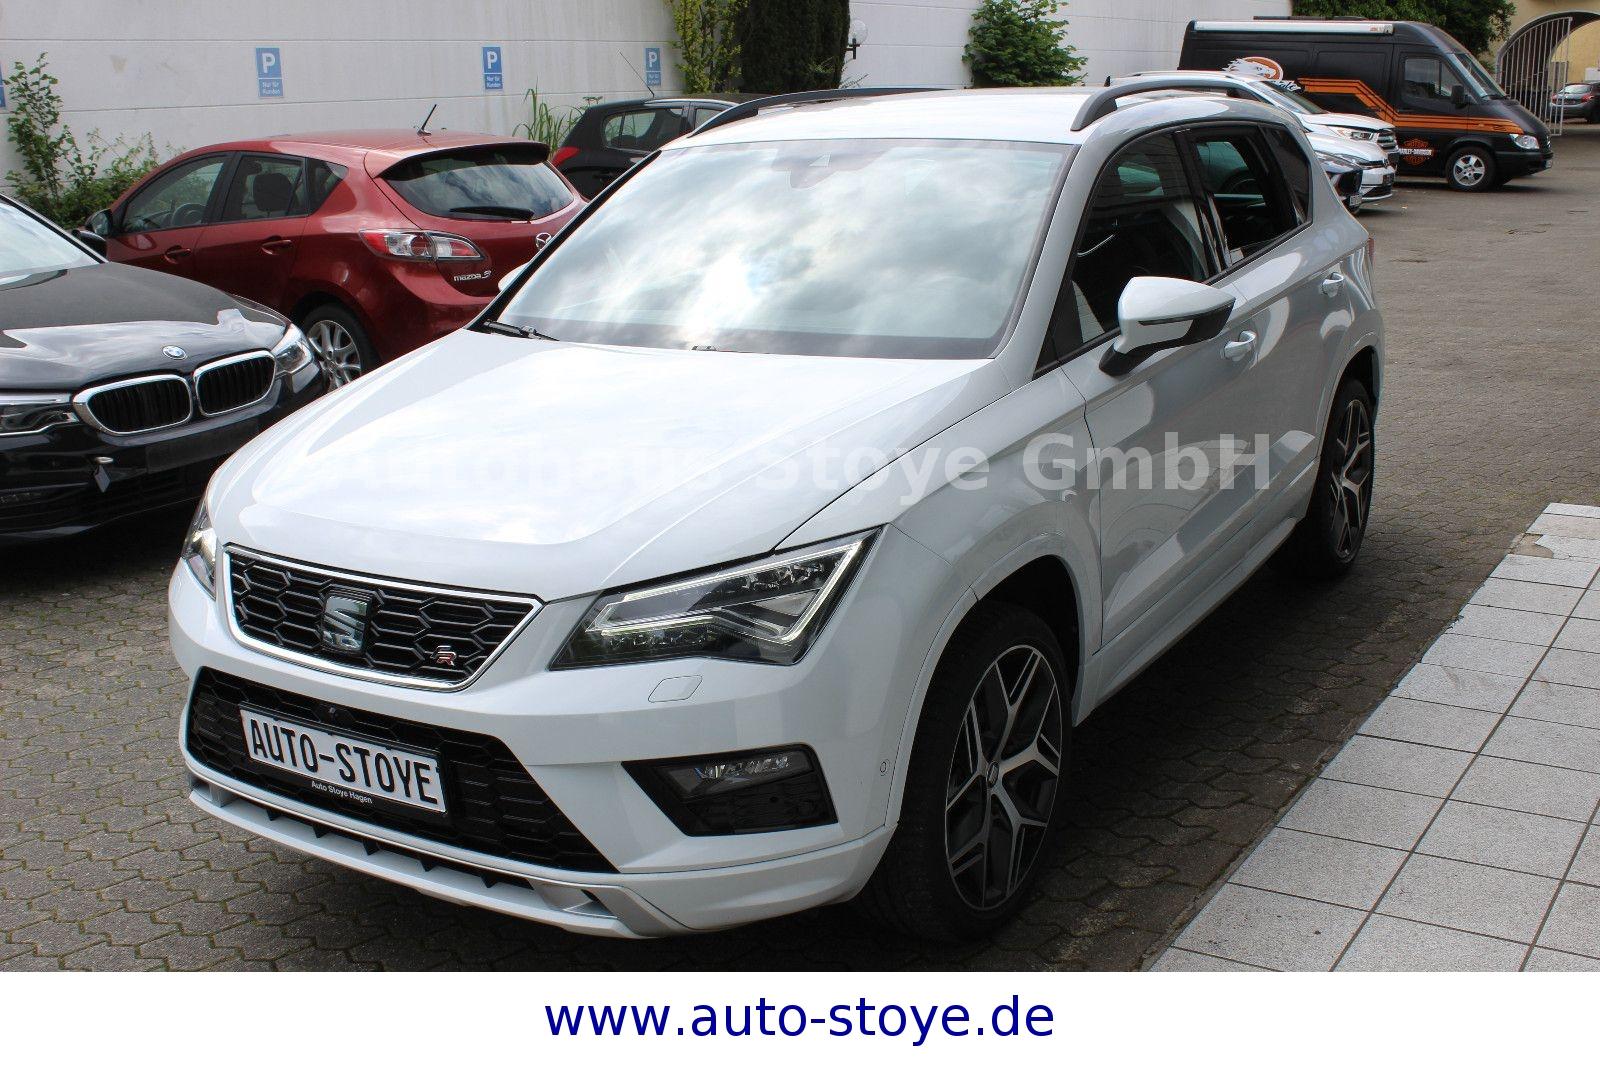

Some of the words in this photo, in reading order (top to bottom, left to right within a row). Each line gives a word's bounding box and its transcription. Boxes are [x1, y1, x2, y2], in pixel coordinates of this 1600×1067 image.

[262, 52, 276, 74] P
[487, 51, 498, 70] P
[649, 51, 658, 68] P
[250, 718, 438, 804] AUTO-STOYE
[311, 780, 328, 792] Auto
[328, 785, 349, 798] Stoye
[349, 790, 373, 804] Hagen
